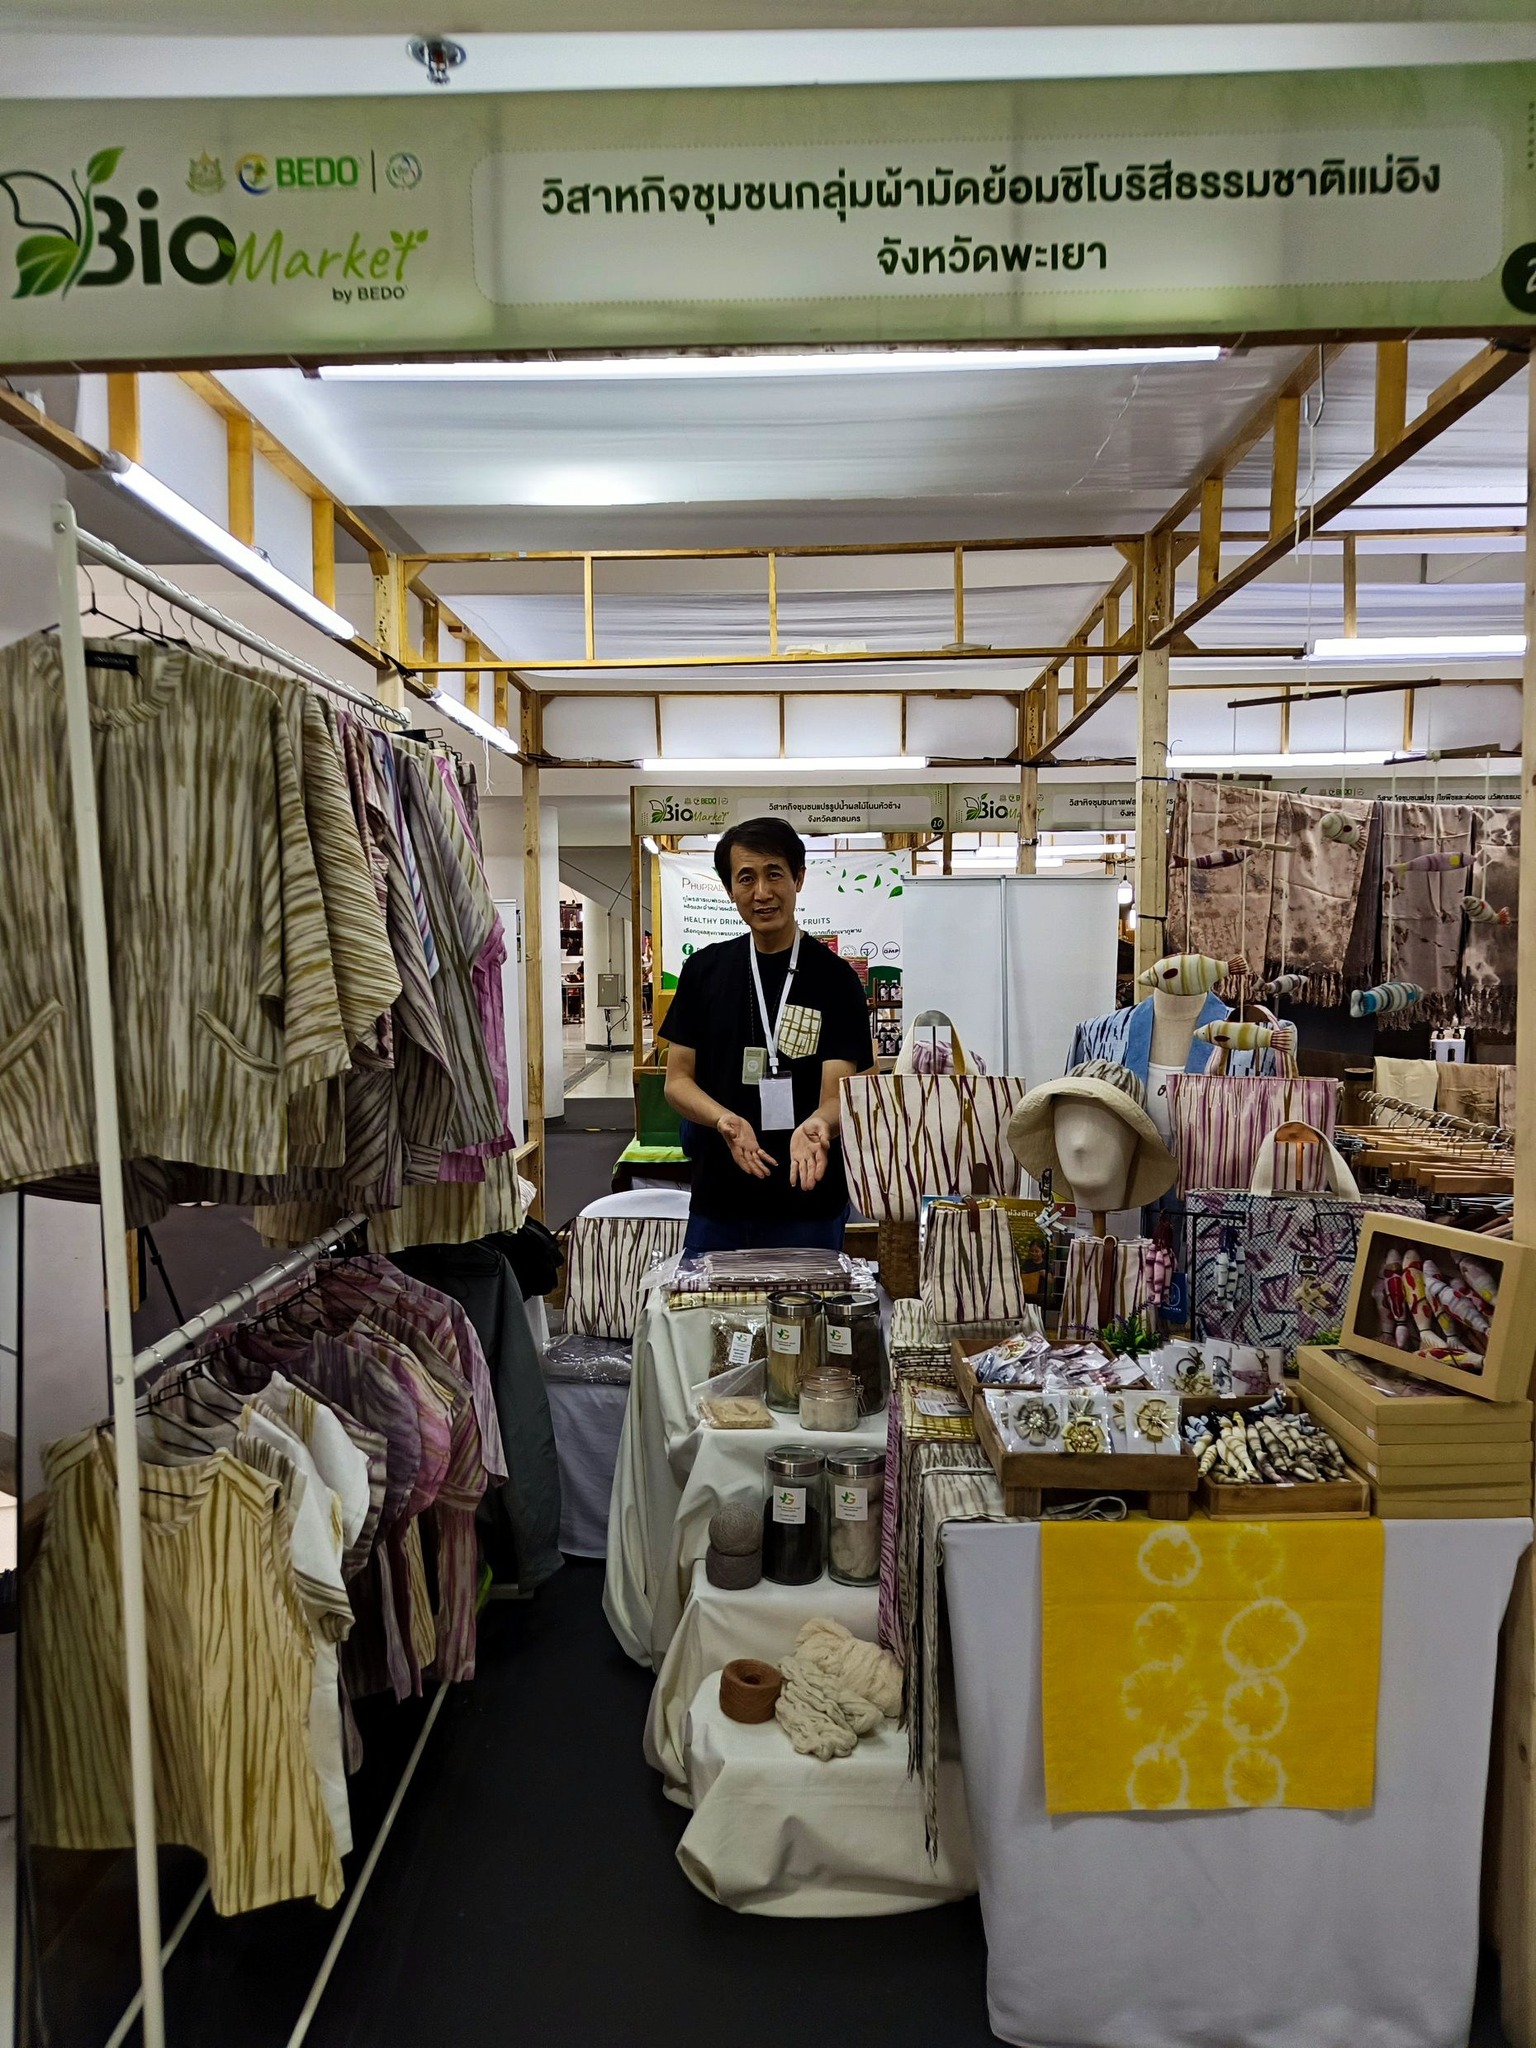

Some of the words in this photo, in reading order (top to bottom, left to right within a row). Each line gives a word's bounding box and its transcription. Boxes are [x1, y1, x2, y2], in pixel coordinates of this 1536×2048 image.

[276, 156, 359, 188] BEDO
[541, 152, 1441, 225] วิสาหกิจชุมชนกลุ่มผ้ามัดย้อมชิโบริสีธรรมชาติแม่อิง
[73, 187, 237, 286] Bio
[228, 229, 428, 285] Market
[876, 234, 1108, 275] จังหวัดพะเยา
[332, 287, 352, 304] by
[358, 286, 405, 300] BEDO
[701, 797, 717, 805] BEDO
[977, 800, 1008, 819] Bio
[664, 802, 694, 822] Bio
[693, 811, 730, 822] Market
[933, 819, 943, 828] 10
[682, 877, 727, 892] PHUPRAIS
[684, 915, 718, 925] HEALTHY
[719, 918, 748, 926] DRINK
[803, 917, 831, 926] FRUITS
